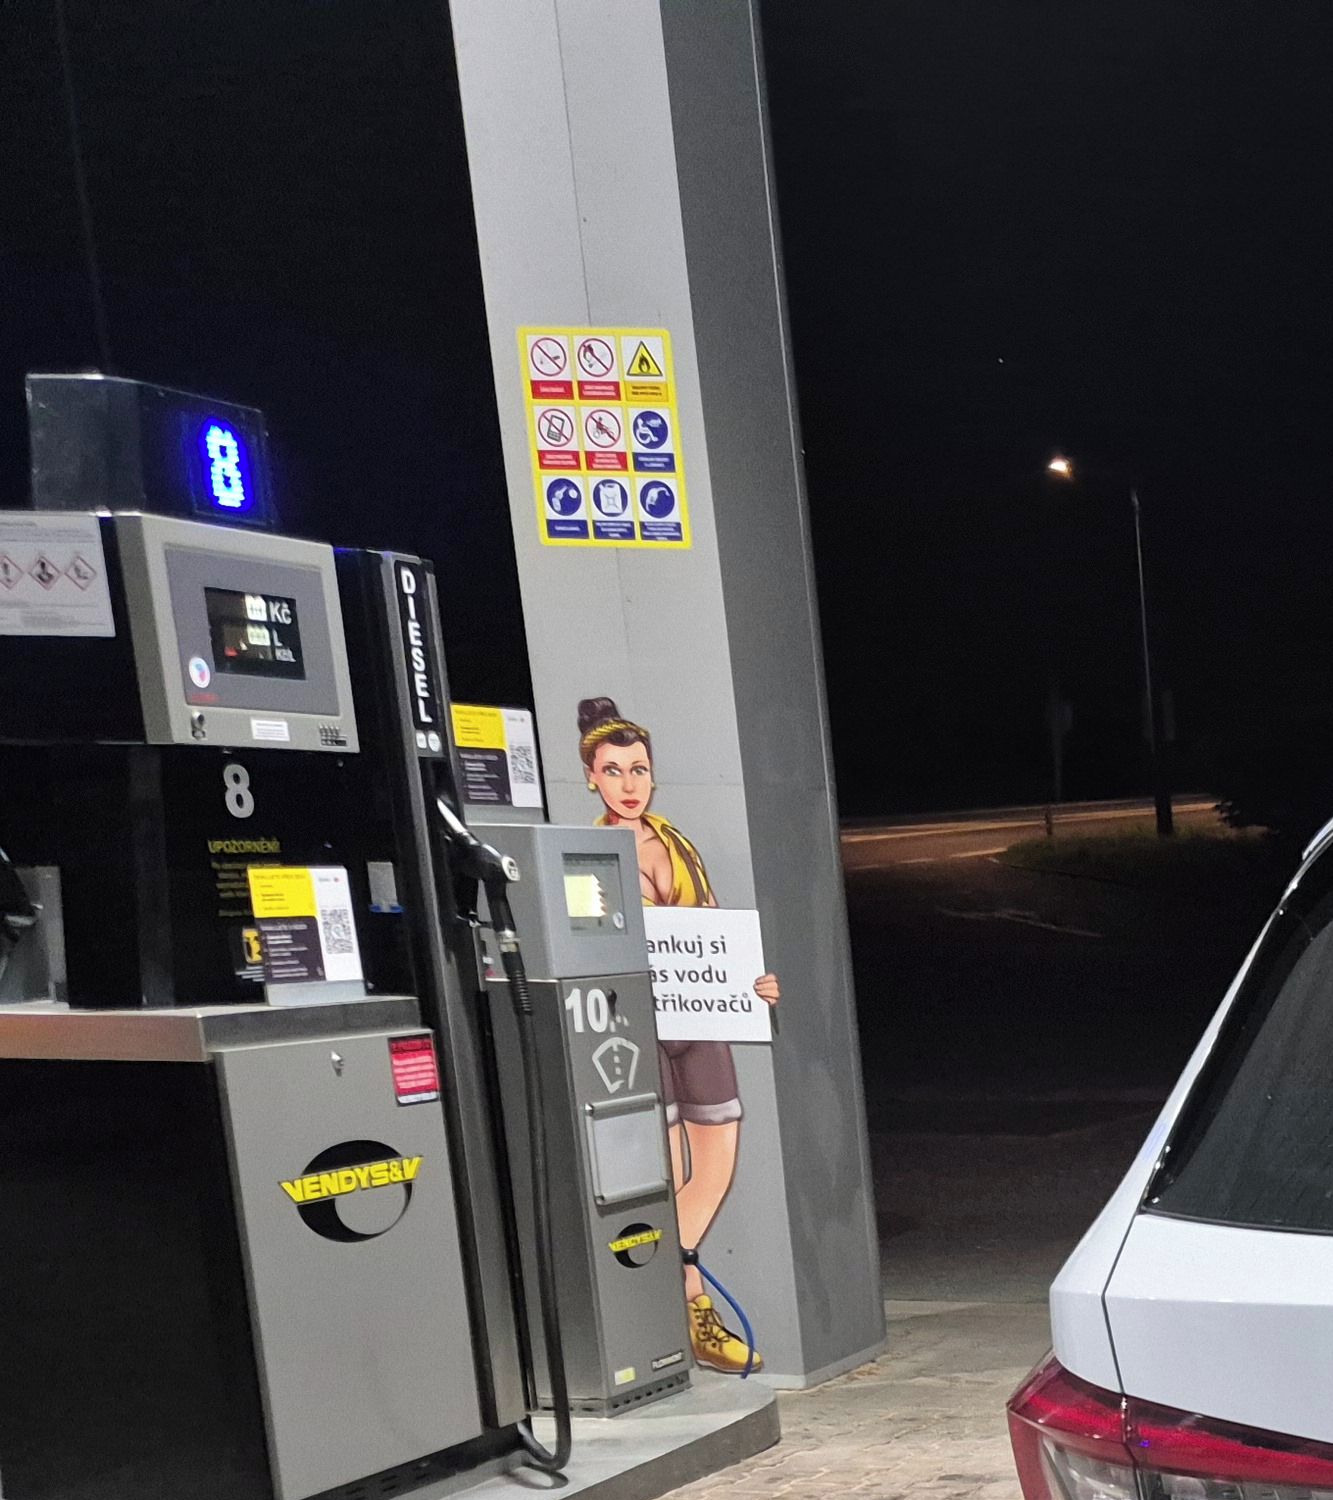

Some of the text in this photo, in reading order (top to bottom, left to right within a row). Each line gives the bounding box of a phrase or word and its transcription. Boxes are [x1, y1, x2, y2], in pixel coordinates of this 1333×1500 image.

[205, 425, 246, 508] 8
[269, 600, 292, 625] Kč
[272, 628, 283, 647] L
[400, 566, 432, 724] DIESEL
[223, 764, 255, 819] 8
[647, 935, 726, 958] ankuj si
[650, 964, 727, 984] ás vodu
[564, 988, 609, 1033] 10
[654, 992, 752, 1013] třikovačů
[279, 1156, 423, 1205] VENDYS&V
